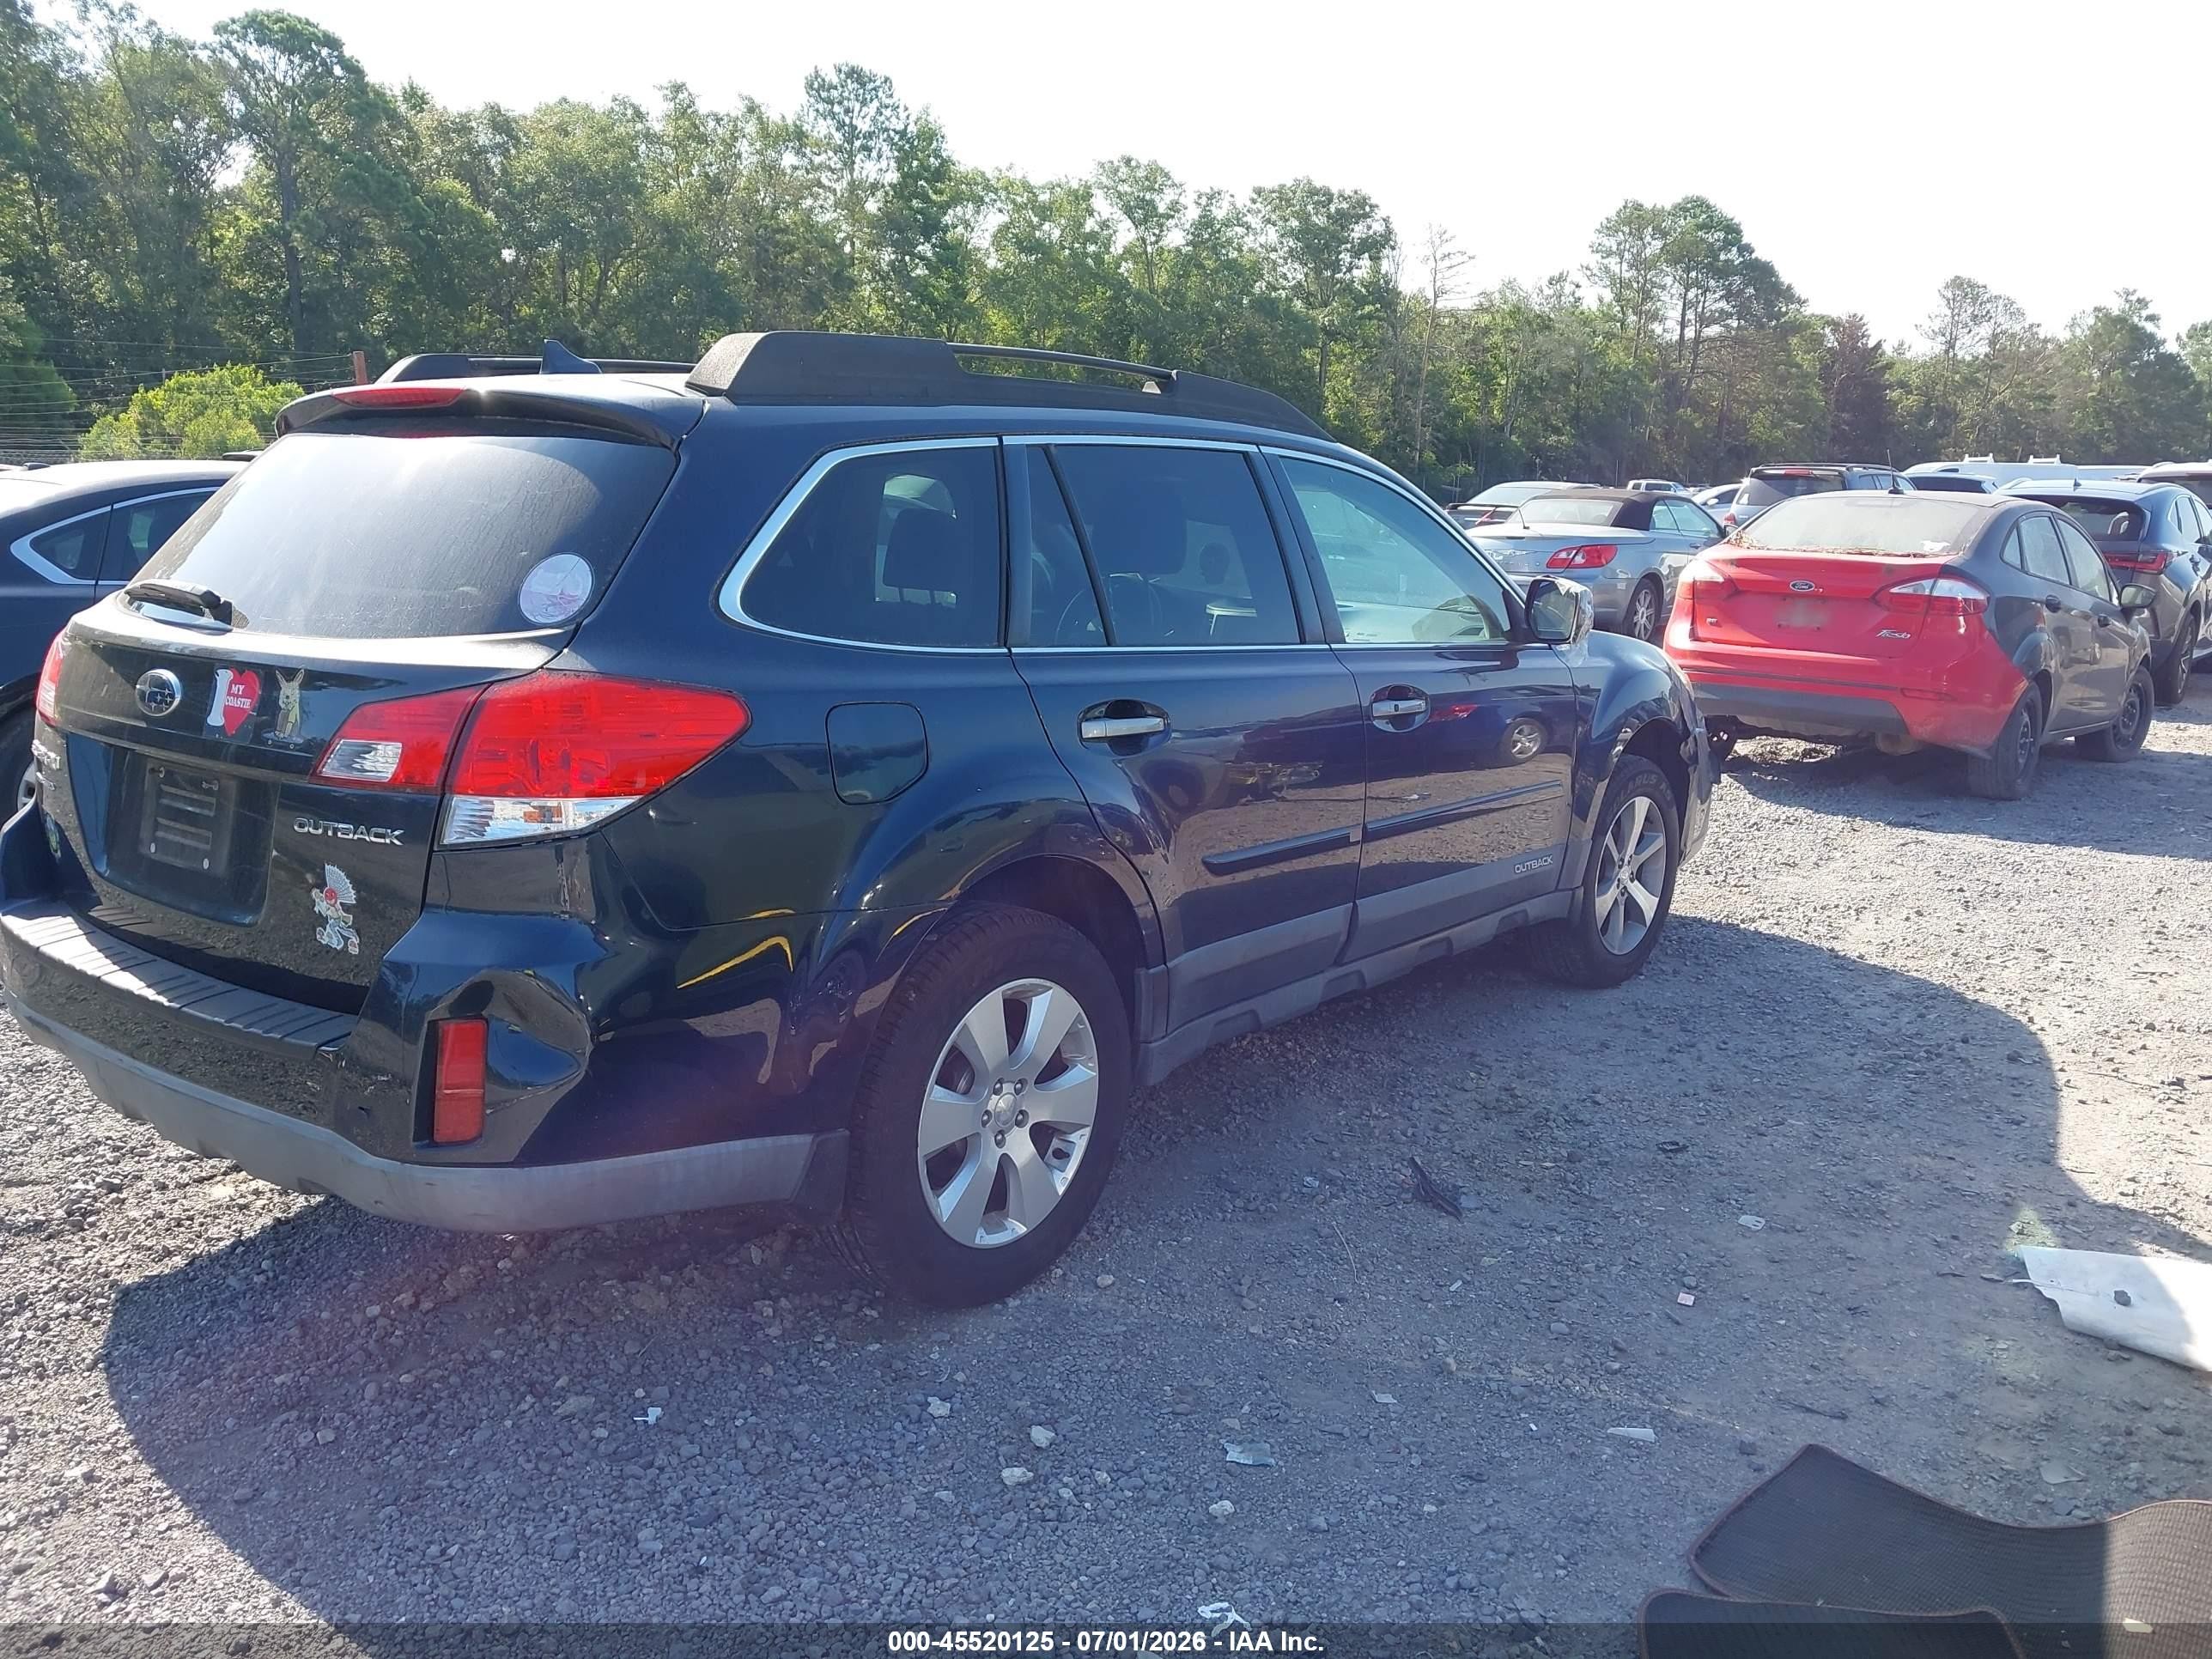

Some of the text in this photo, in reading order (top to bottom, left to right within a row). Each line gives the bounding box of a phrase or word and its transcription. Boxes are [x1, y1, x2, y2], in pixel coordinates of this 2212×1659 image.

[230, 684, 246, 696] MY
[225, 696, 252, 708] COASTIE
[294, 817, 404, 846] OUTBACK
[1515, 855, 1553, 873] OUTBACK
